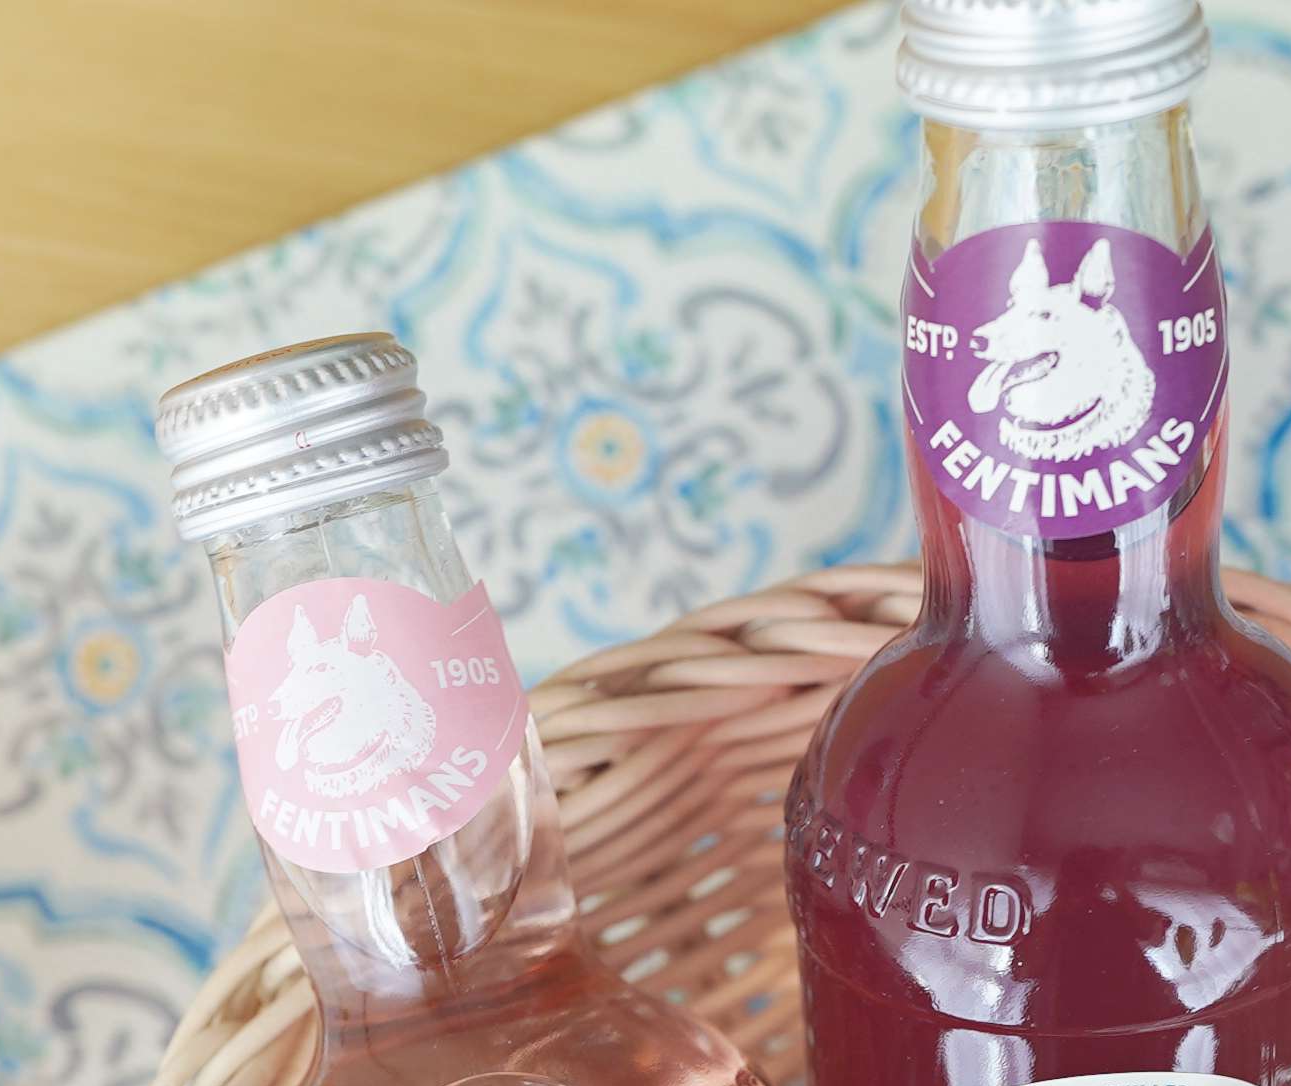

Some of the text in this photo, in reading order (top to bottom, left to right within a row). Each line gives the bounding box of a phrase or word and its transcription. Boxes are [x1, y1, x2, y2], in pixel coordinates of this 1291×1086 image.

[1158, 308, 1217, 355] 1905
[929, 416, 1195, 518] FENTIMANS
[430, 657, 500, 689] 1905
[260, 745, 487, 850] FENTIMANS
